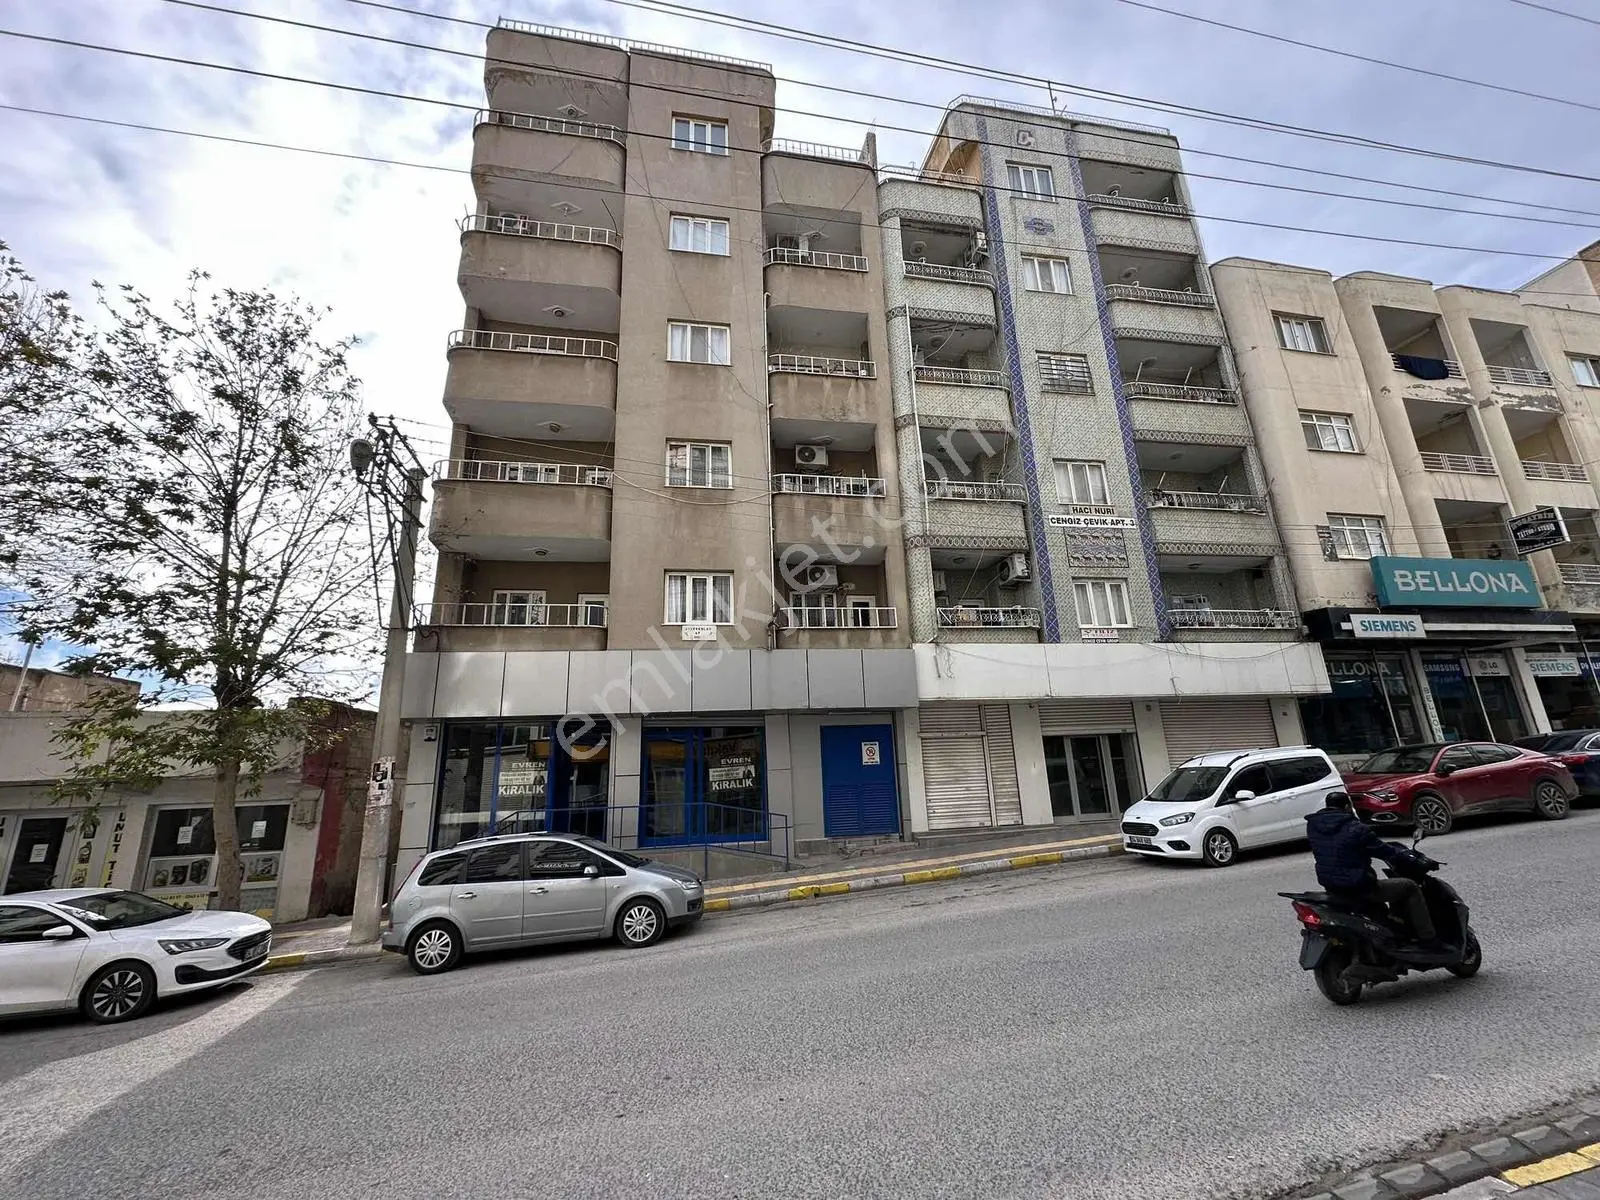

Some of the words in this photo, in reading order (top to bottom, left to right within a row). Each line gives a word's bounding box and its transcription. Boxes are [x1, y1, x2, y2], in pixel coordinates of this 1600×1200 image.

[1072, 506, 1092, 514] HACI
[1393, 569, 1529, 594] BELLONA
[1360, 620, 1416, 632] SIEMENS
[1423, 663, 1460, 673] SAMSUNG
[1529, 661, 1576, 672] SIEMENS
[721, 757, 751, 765] EVREN
